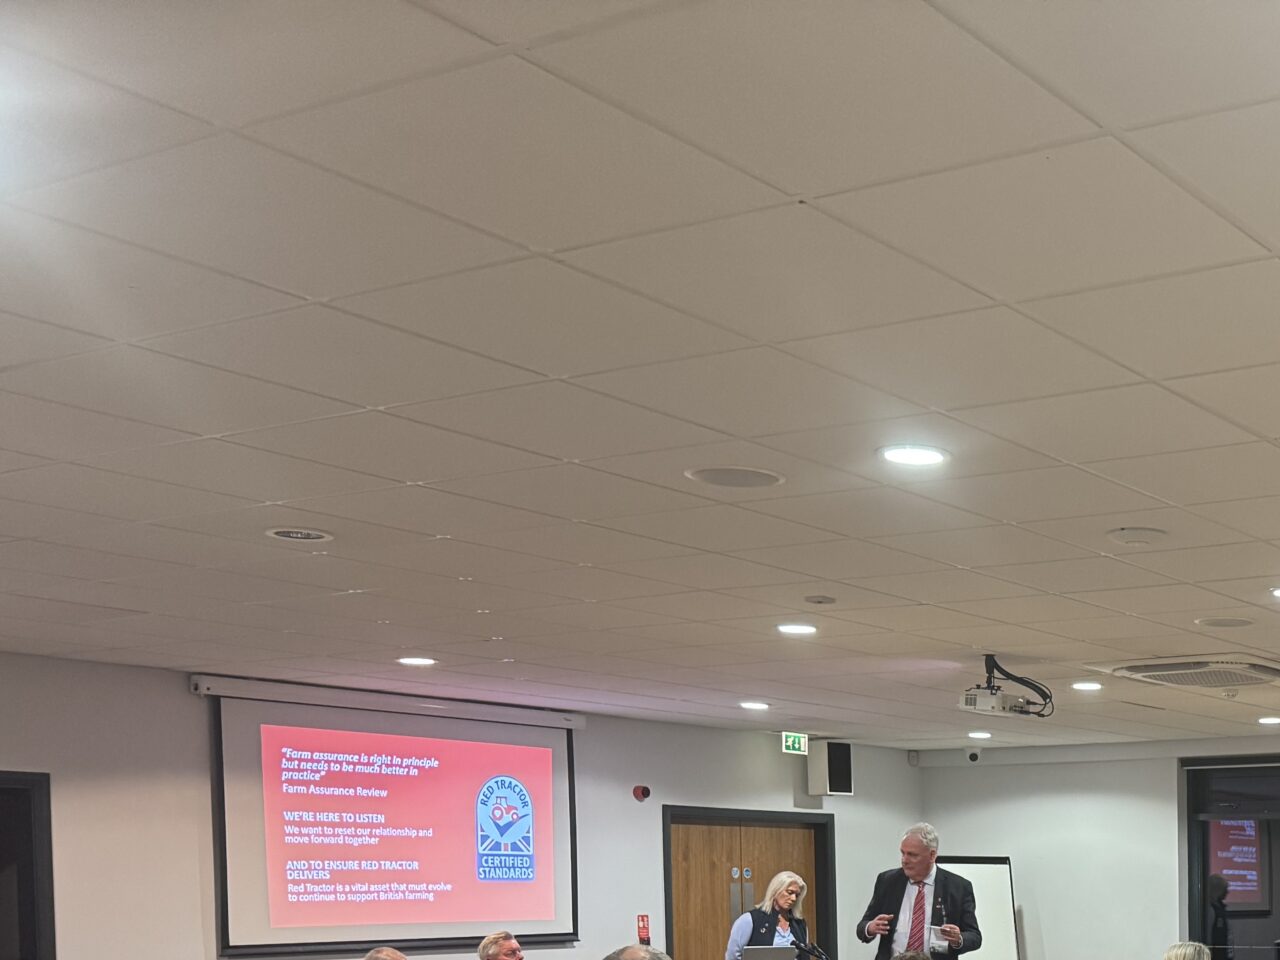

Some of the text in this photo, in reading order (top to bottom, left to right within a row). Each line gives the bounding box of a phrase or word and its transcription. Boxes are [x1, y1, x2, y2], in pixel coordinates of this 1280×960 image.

[313, 752, 360, 762] assurance
[361, 753, 369, 763] is
[370, 754, 391, 765] right
[393, 756, 402, 765] in
[403, 757, 439, 768] principle
[281, 758, 418, 776] but needs to be much better in
[283, 783, 388, 797] Farm Assurance Review
[480, 779, 529, 808] RED TRACTOR
[316, 812, 341, 822] HERE
[341, 813, 355, 823] TO
[355, 814, 385, 823] LISTEN
[284, 825, 300, 834] We
[300, 827, 323, 835] want
[323, 826, 334, 835] to
[334, 827, 356, 836] reset
[372, 827, 417, 838] relationship
[418, 828, 433, 837] and
[284, 834, 380, 847] move forward together
[286, 861, 419, 870] AND TO ENSURE RED TRACTOR
[481, 855, 530, 867] CERTIFIED
[287, 870, 331, 880] DELIVERS
[479, 867, 534, 879] STANDARDS
[287, 883, 305, 893] Red
[305, 883, 336, 893] Tractor
[336, 883, 344, 892] is
[351, 883, 369, 892] vital
[370, 884, 390, 892] asset
[391, 883, 407, 891] that
[408, 883, 427, 891] must
[428, 882, 453, 891] evolve
[287, 891, 434, 903] to continue to support British farming
